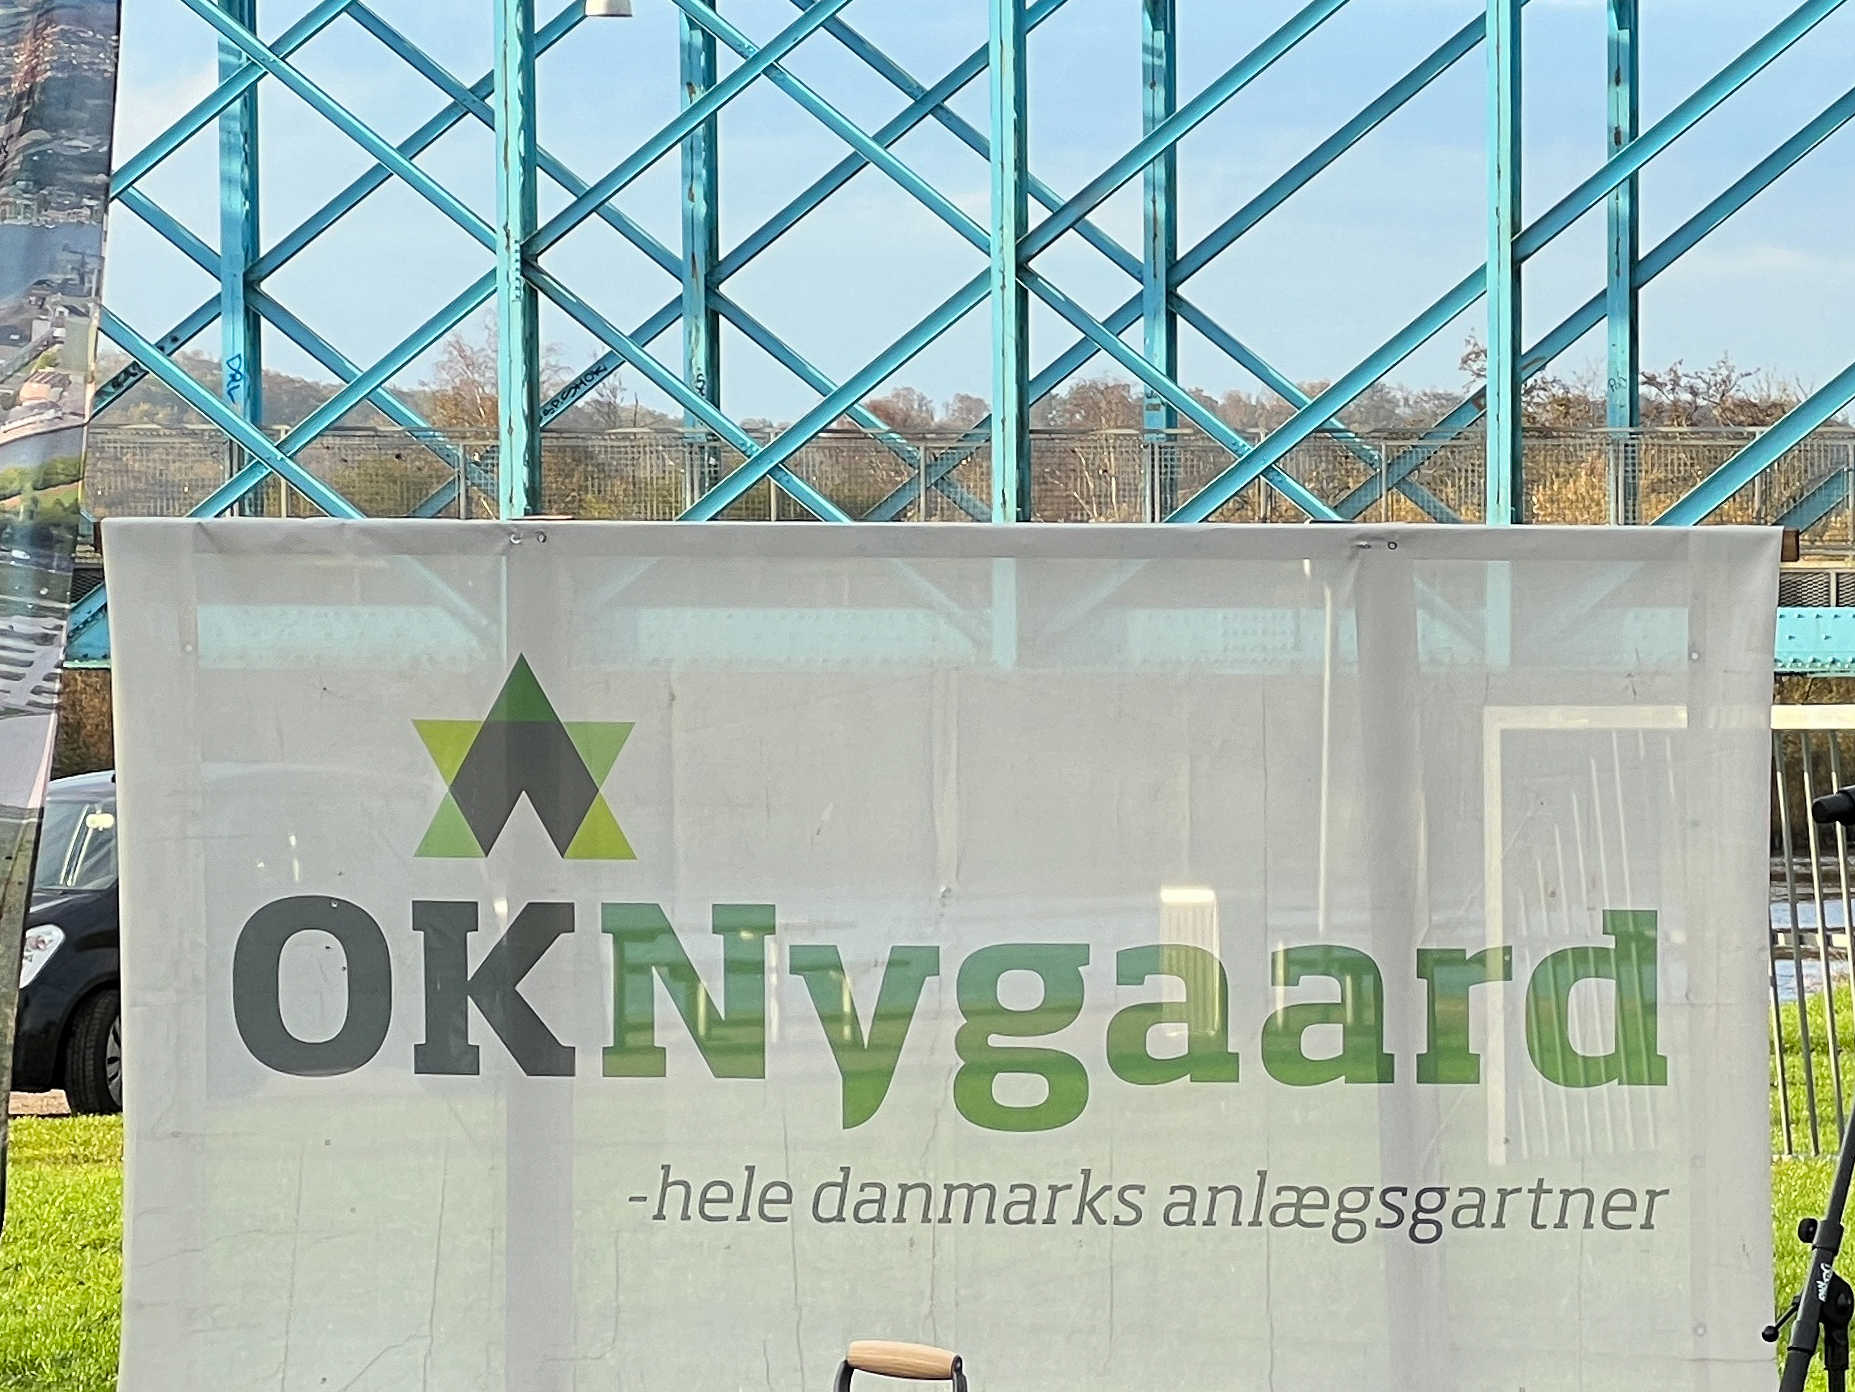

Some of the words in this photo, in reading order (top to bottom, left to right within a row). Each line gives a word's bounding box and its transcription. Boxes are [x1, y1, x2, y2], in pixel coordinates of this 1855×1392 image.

[628, 1164, 795, 1224] -hele
[811, 1166, 1147, 1227] danmarks
[1163, 1170, 1671, 1245] anlægsgartner
